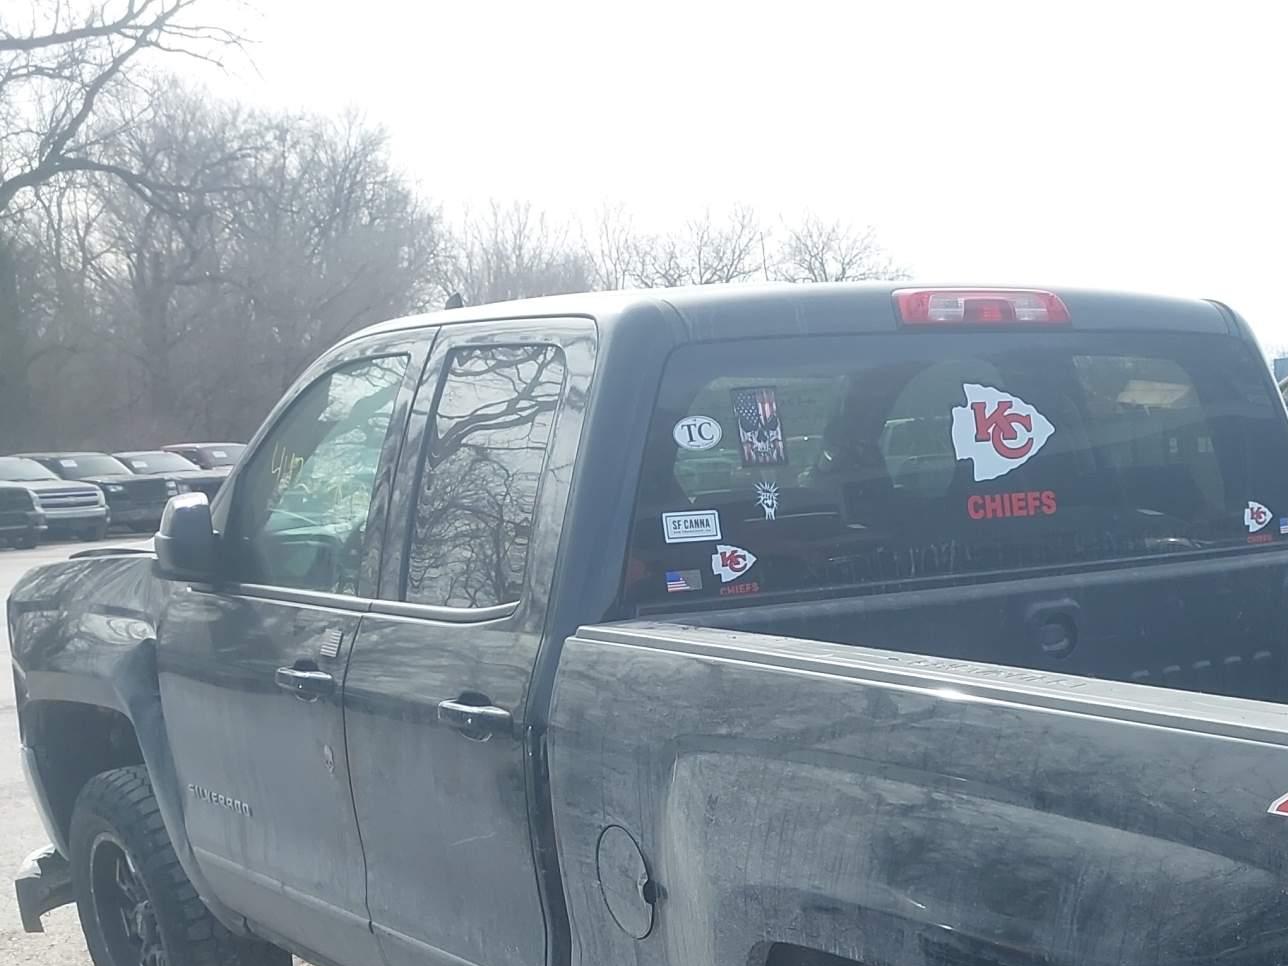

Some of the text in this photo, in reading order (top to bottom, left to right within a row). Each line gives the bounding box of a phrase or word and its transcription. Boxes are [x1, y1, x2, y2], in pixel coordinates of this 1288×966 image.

[681, 422, 714, 443] TC
[971, 400, 1034, 459] KC
[967, 490, 1057, 520] CHIEFS
[683, 518, 711, 530] CANNA
[720, 549, 747, 573] KC
[720, 581, 760, 595] CHIEFS
